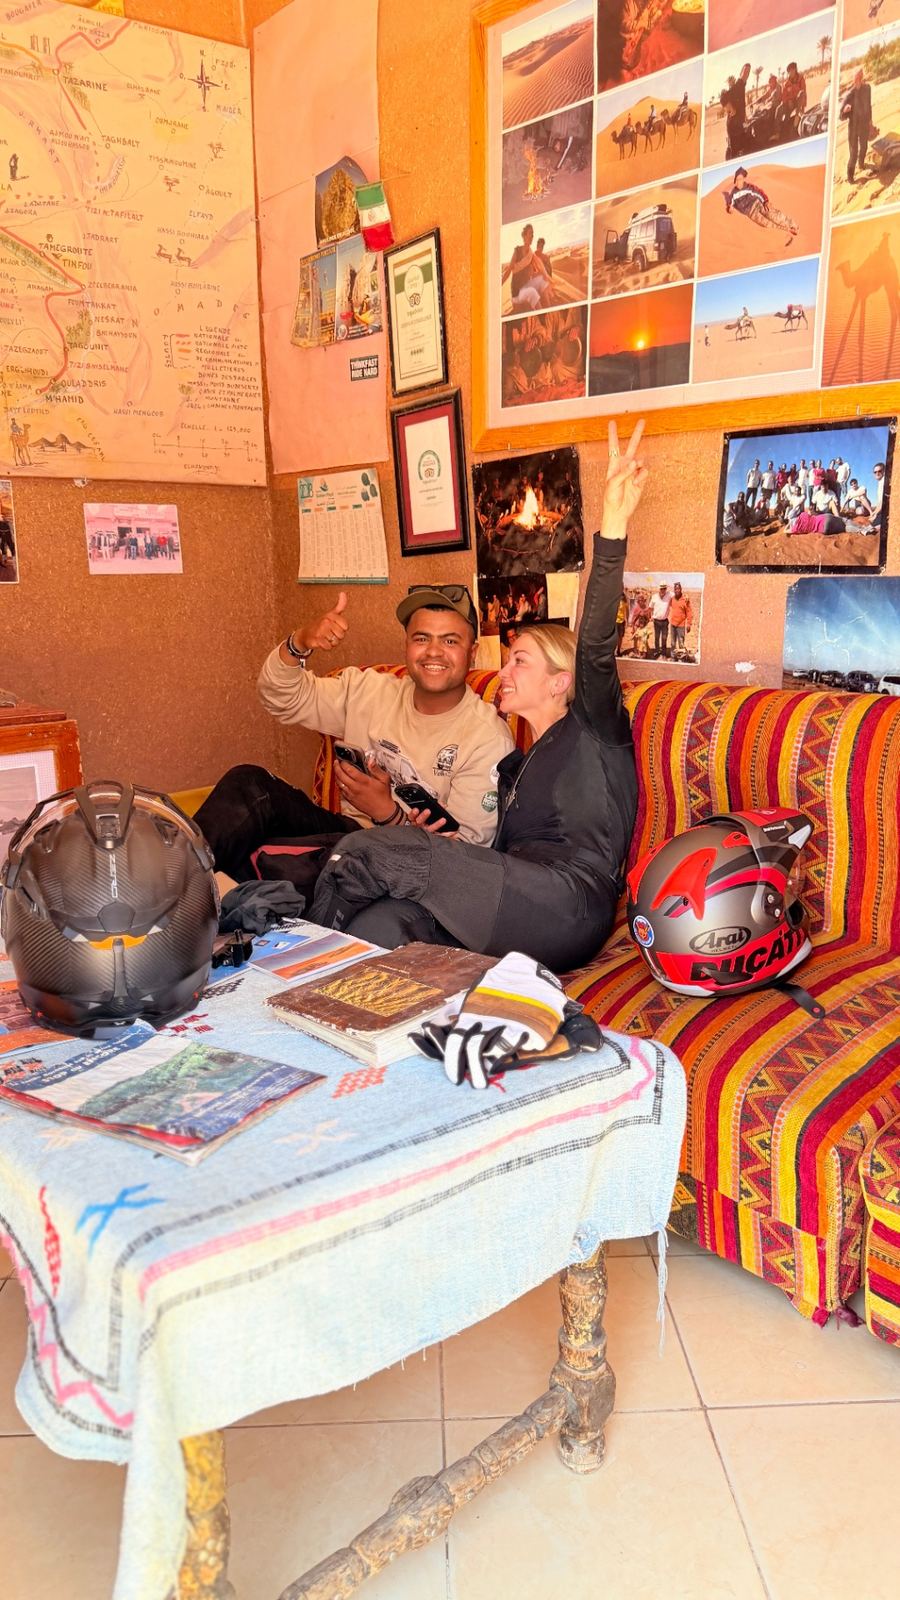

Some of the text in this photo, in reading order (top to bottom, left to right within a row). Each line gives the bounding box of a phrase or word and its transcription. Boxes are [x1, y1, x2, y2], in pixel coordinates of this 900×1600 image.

[62, 75, 108, 92] TAZARINE
[695, 928, 744, 949] Arai
[689, 926, 804, 983] DUCATI
